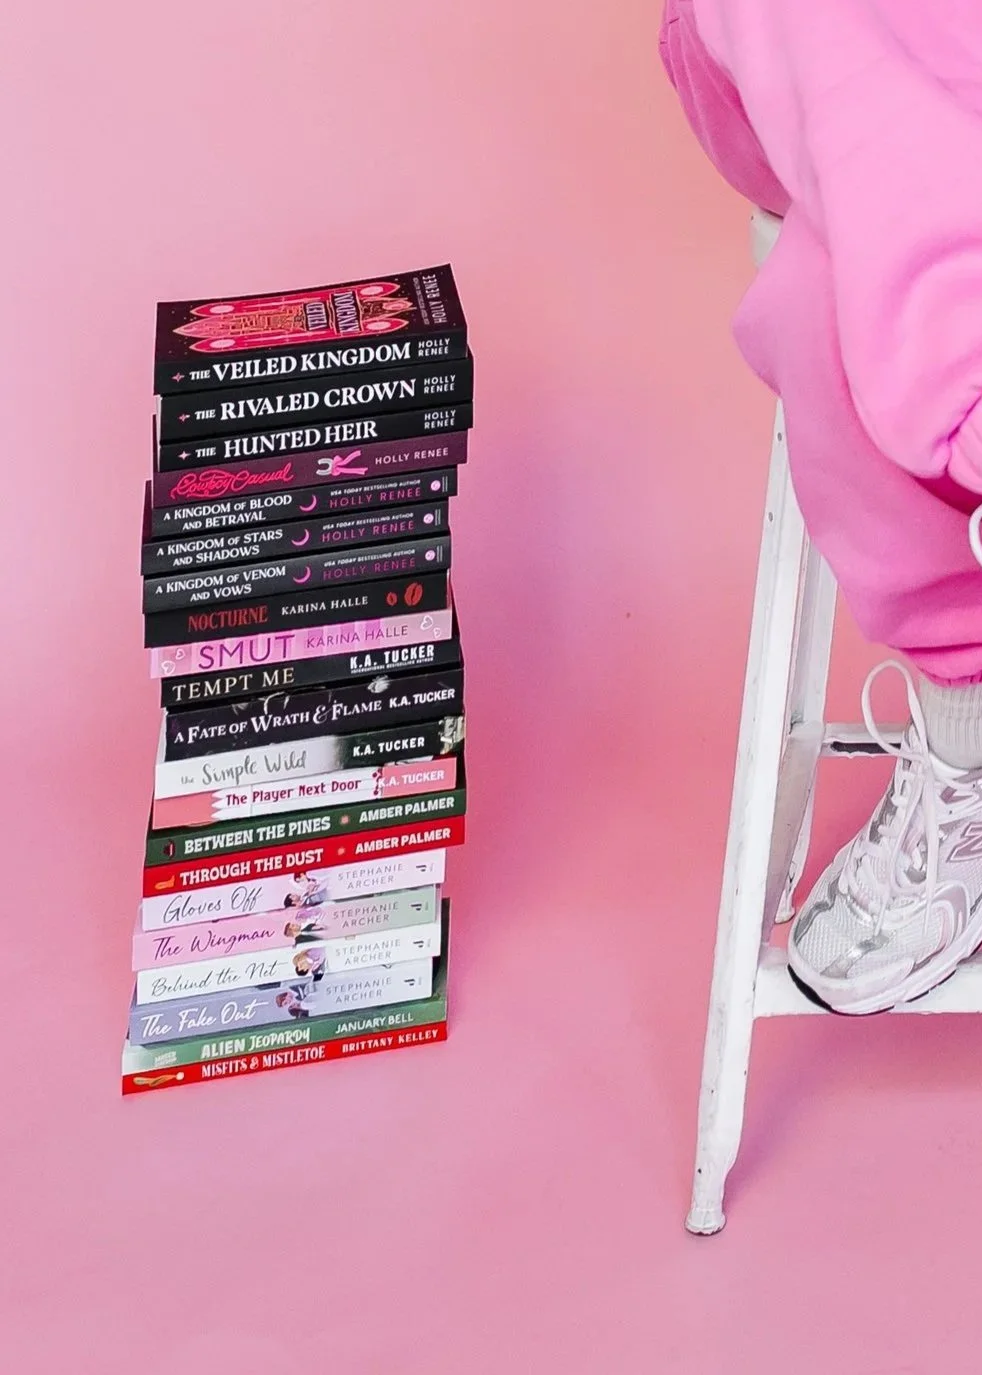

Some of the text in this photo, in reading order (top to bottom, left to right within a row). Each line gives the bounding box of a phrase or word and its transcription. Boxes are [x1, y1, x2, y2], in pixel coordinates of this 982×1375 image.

[422, 274, 447, 324] HOLLY RENEE
[333, 291, 359, 333] KINGDOM
[418, 338, 451, 349] HOLLY
[418, 346, 449, 357] RENEE
[189, 343, 411, 381] THE VEILED KINGDOM
[424, 375, 456, 385] HOLLY
[424, 383, 455, 394] RENEE
[194, 379, 416, 420] THE RIVALED CROWN
[424, 409, 457, 420] HOLLY
[424, 418, 455, 429] RENEE
[196, 420, 378, 458] THE HUNTED HEIR
[375, 447, 449, 465] HOLLY RENEE
[170, 463, 293, 499] Cowboy Casual
[163, 512, 170, 521] A
[174, 504, 231, 520] KINGDOM
[250, 495, 292, 509] BLOOD
[329, 488, 421, 508] HOLLY RENEE
[182, 511, 266, 531] AND BETRAYAL
[322, 521, 414, 542] HOLLY RENEE
[157, 547, 164, 556] A
[167, 539, 225, 555] KINGDOM
[243, 529, 283, 543] STARS
[173, 545, 260, 566] AND SHADOWS
[156, 586, 163, 594] A
[166, 577, 223, 594] KINGDOM
[243, 567, 286, 582] VENOM
[323, 559, 415, 580] HOLLY RENEE
[190, 584, 252, 602] AND VOWS
[281, 597, 368, 616] KARINA HALLE
[189, 606, 268, 632] NOCTURNE
[307, 626, 408, 649] KARINA HALLE
[199, 636, 295, 669] SMUT
[350, 645, 434, 670] K.A. TUCKER
[173, 667, 295, 701] TEMPT ME
[389, 689, 455, 708] K.A. TUCKER
[174, 733, 184, 743] A
[229, 722, 247, 734] OF
[312, 706, 331, 723] &
[353, 737, 425, 756] K.A. TUCKER
[201, 759, 257, 786] Simple
[264, 752, 306, 774] Wild
[378, 770, 444, 787] K.A. TUCKER
[226, 779, 361, 806] The Player Next Door
[359, 797, 455, 823] AMBER PALMER
[184, 816, 331, 854] BETWEEN THE PINES
[355, 828, 451, 854] AMBER PALMER
[180, 849, 323, 885] THROUGH THE DUST
[337, 864, 402, 880] STEPHANIE
[347, 876, 394, 889] ARCHER
[164, 886, 262, 923] Gloves Off
[334, 902, 399, 919] STEPHANIE
[342, 914, 389, 928] ARCHER
[154, 928, 274, 960] The Wingman
[336, 940, 401, 957] STEPHANIE
[345, 952, 392, 965] ARCHER
[151, 961, 284, 996] Behind the Net
[327, 977, 392, 995] STEPHANIE
[336, 989, 382, 1004] ARCHER
[141, 1001, 264, 1038] The Fake Out
[336, 1013, 414, 1034] JANUARY BELL
[202, 1041, 245, 1059] ALIEN
[249, 1028, 311, 1052] JEOPARDY
[342, 1029, 438, 1053] BRITTANY KELLEY
[202, 1046, 325, 1078] MISFITS & MISTLETOE
